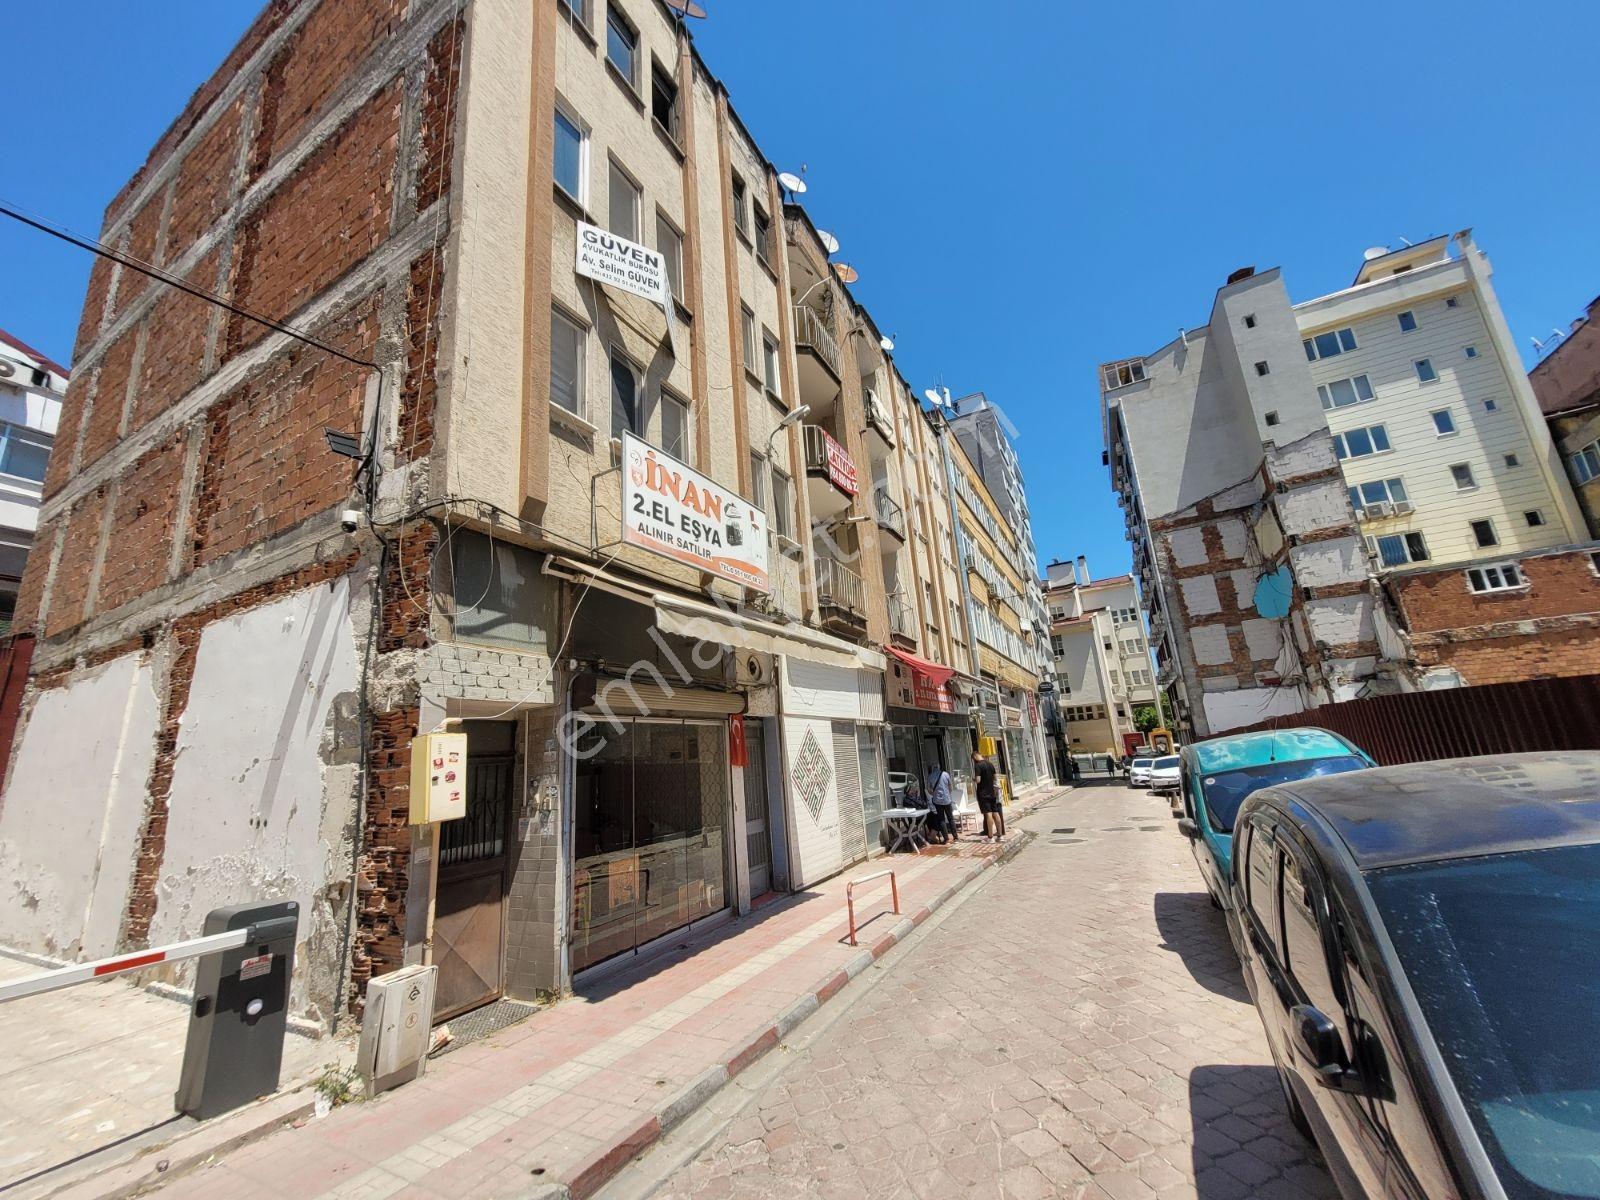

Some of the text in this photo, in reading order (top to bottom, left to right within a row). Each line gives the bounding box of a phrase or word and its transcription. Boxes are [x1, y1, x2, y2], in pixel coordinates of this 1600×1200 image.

[582, 242, 626, 265] AVUKATLIK
[583, 230, 658, 268] GÜVEN
[582, 253, 660, 290] Av. Selim GÜVEN
[643, 450, 723, 524] İNAN
[633, 493, 722, 548] 2.EL EŞYA
[638, 522, 712, 559] ALINIR SATILIR
